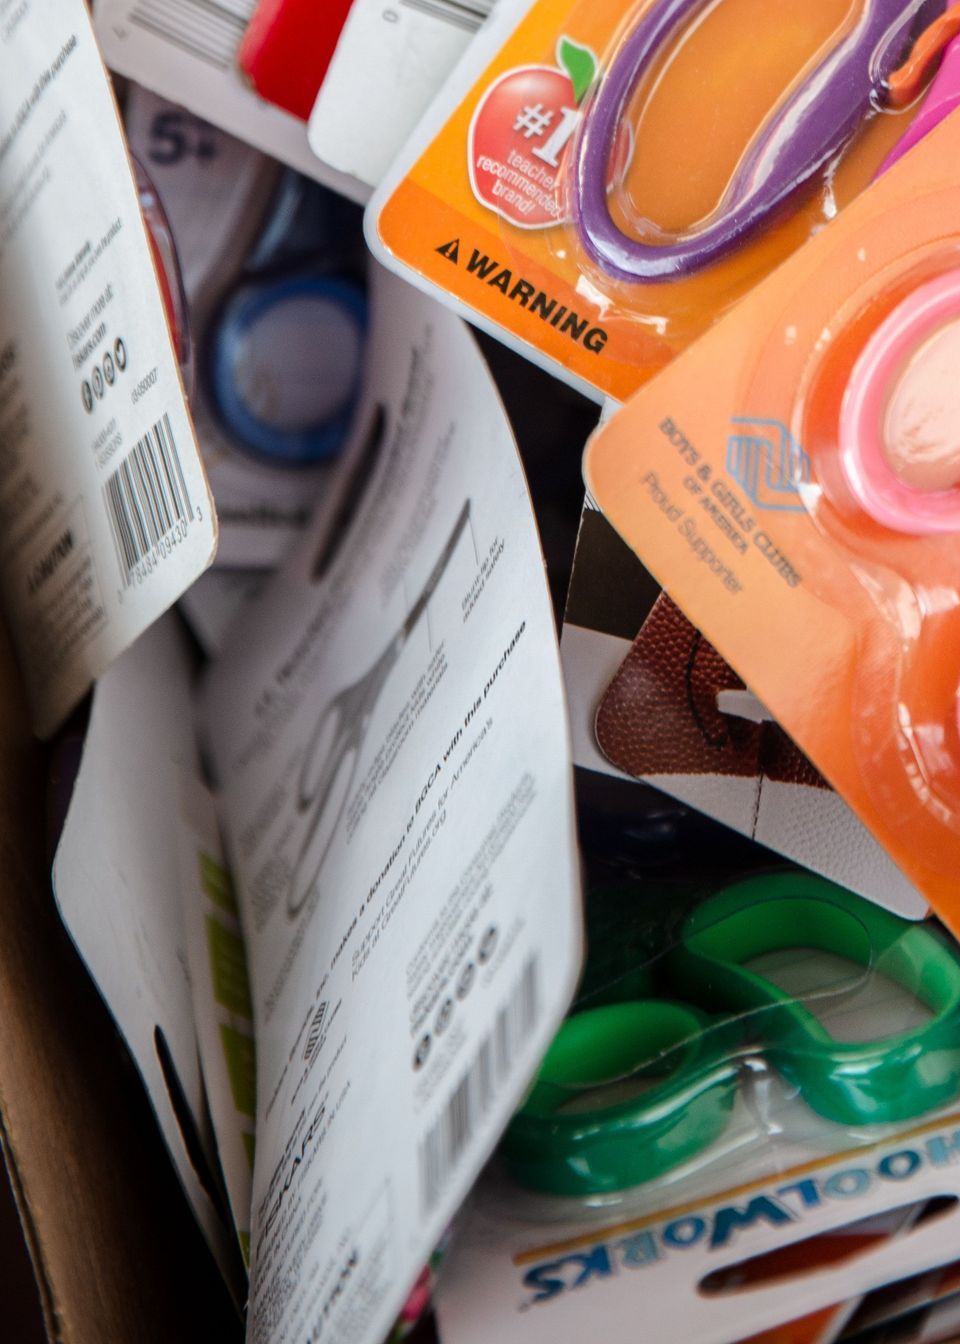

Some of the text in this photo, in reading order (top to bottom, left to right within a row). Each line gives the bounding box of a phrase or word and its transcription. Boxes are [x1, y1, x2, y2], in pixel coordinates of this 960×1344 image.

[380, 7, 401, 25] 0
[511, 102, 583, 168] #1
[492, 179, 536, 216] brand!
[464, 248, 609, 356] WARNING
[643, 470, 743, 595] Proud Supporter
[659, 416, 802, 589] BOYS & GIRLS CLUBS
[683, 474, 749, 555] OF AMERICA
[366, 834, 406, 904] donation
[406, 815, 415, 833] to
[415, 763, 442, 814] BGCA
[443, 728, 464, 763] with
[463, 696, 483, 728] this
[483, 620, 526, 700] purchase
[384, 863, 408, 908] Great
[408, 809, 438, 867] Futures
[437, 785, 450, 810] for
[450, 716, 494, 790] America's
[370, 928, 381, 950] at
